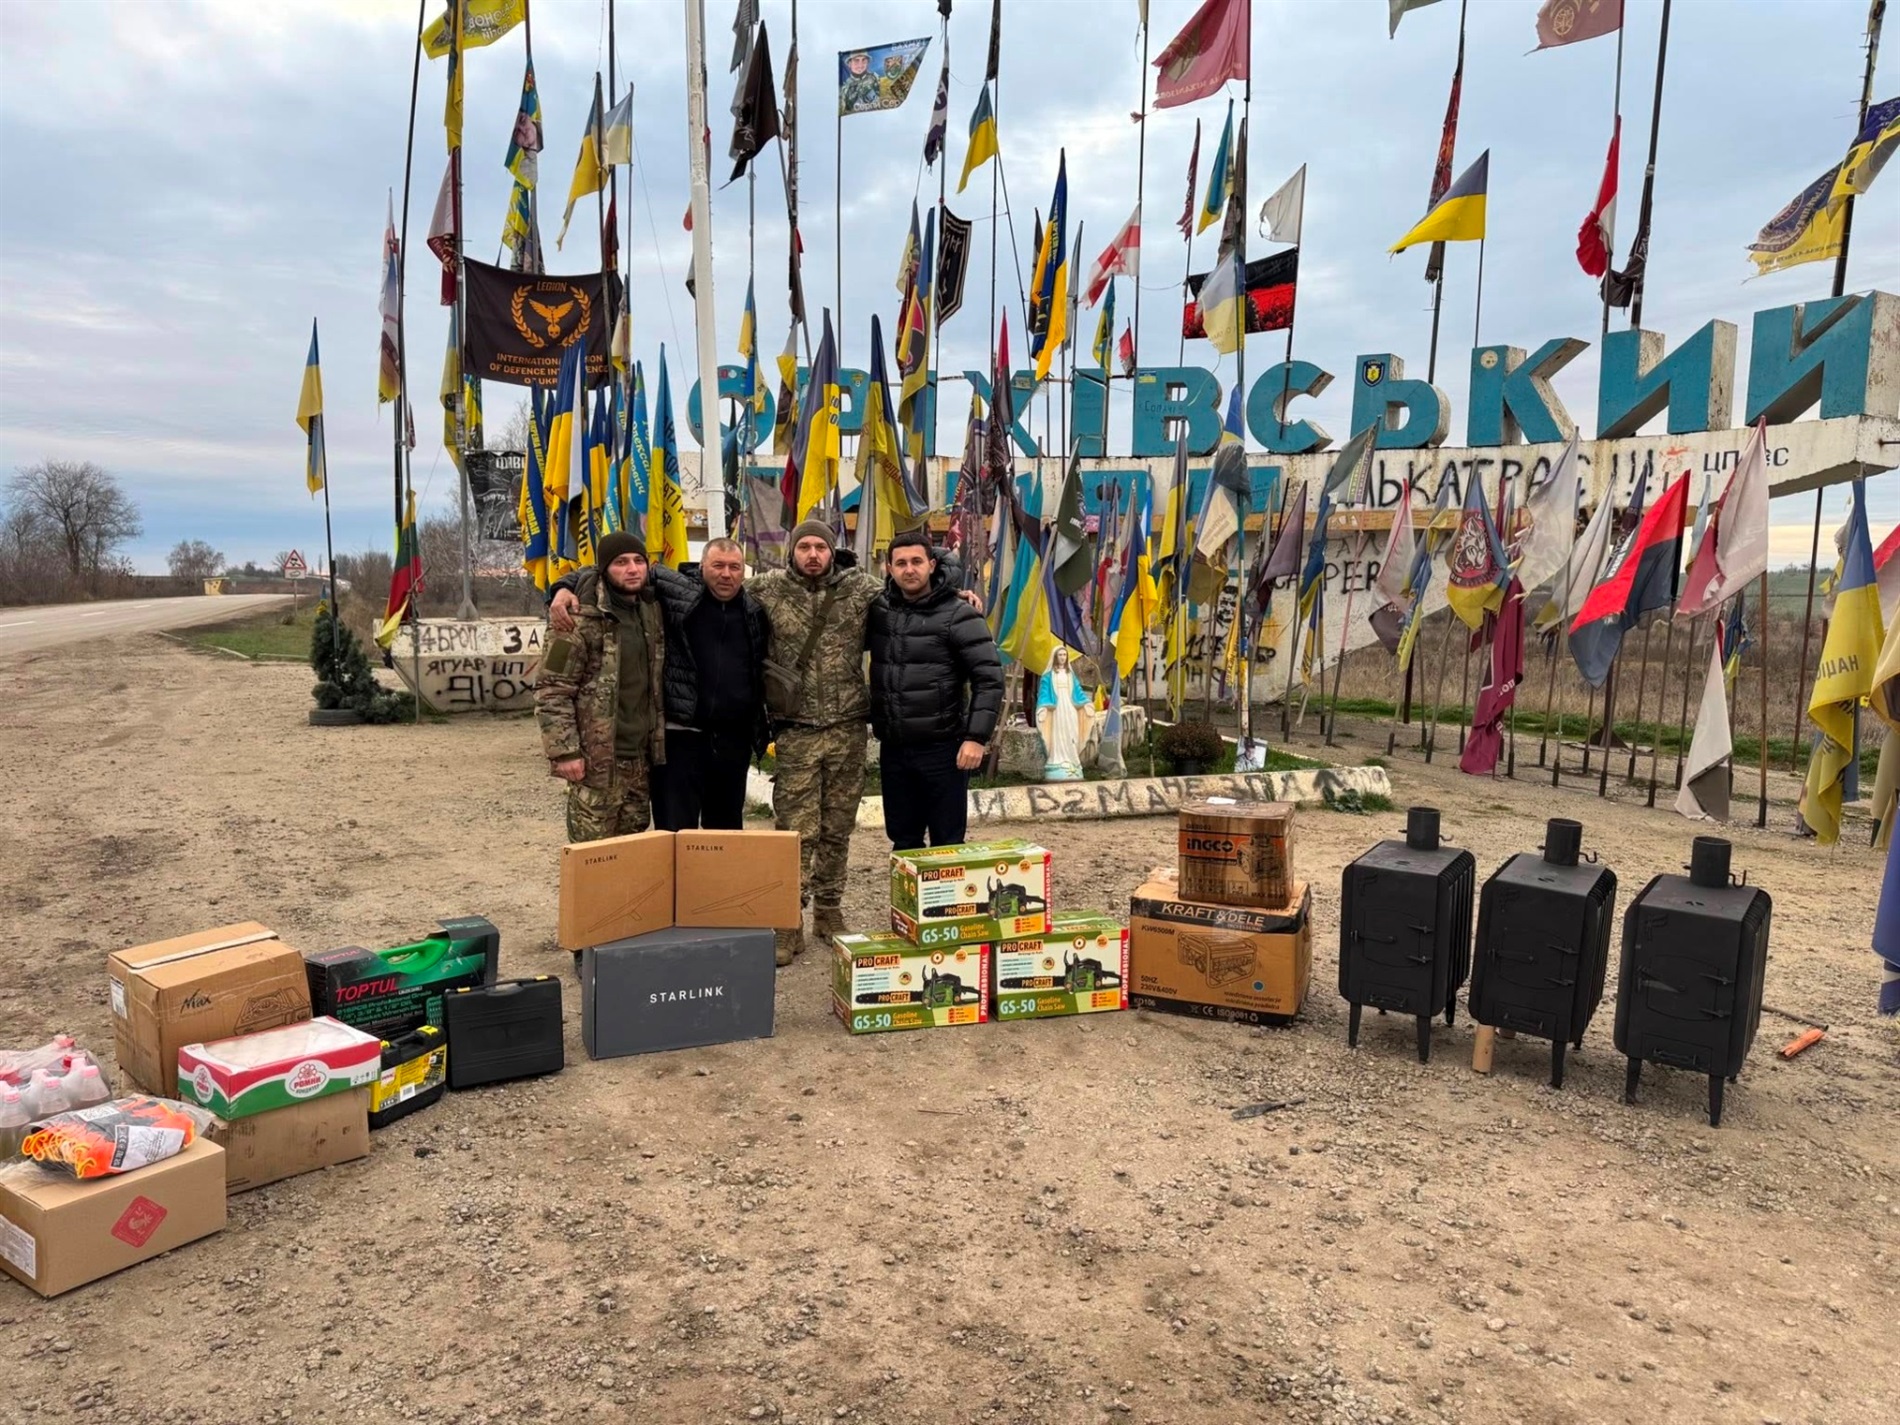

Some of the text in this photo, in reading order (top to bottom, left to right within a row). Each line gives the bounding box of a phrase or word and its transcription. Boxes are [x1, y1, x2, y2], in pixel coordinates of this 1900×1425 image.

[536, 280, 567, 293] LEGION
[503, 365, 545, 375] DEFENCE
[686, 844, 724, 852] STARLINK
[585, 854, 618, 865] STARLINK
[959, 924, 985, 932] Gasoline
[960, 929, 989, 939] Chain Saw
[921, 926, 959, 944] GS-50
[1121, 938, 1129, 1001] PROFESSIONAL
[335, 977, 397, 1003] TOPTUL
[980, 953, 988, 1017] PROFESSIONAL
[650, 985, 724, 1004] STARLINK
[1037, 997, 1061, 1005] Gasoline
[1000, 998, 1036, 1014] GS-50
[853, 1013, 892, 1030] GS-50
[294, 1076, 322, 1089] РОМНИ
